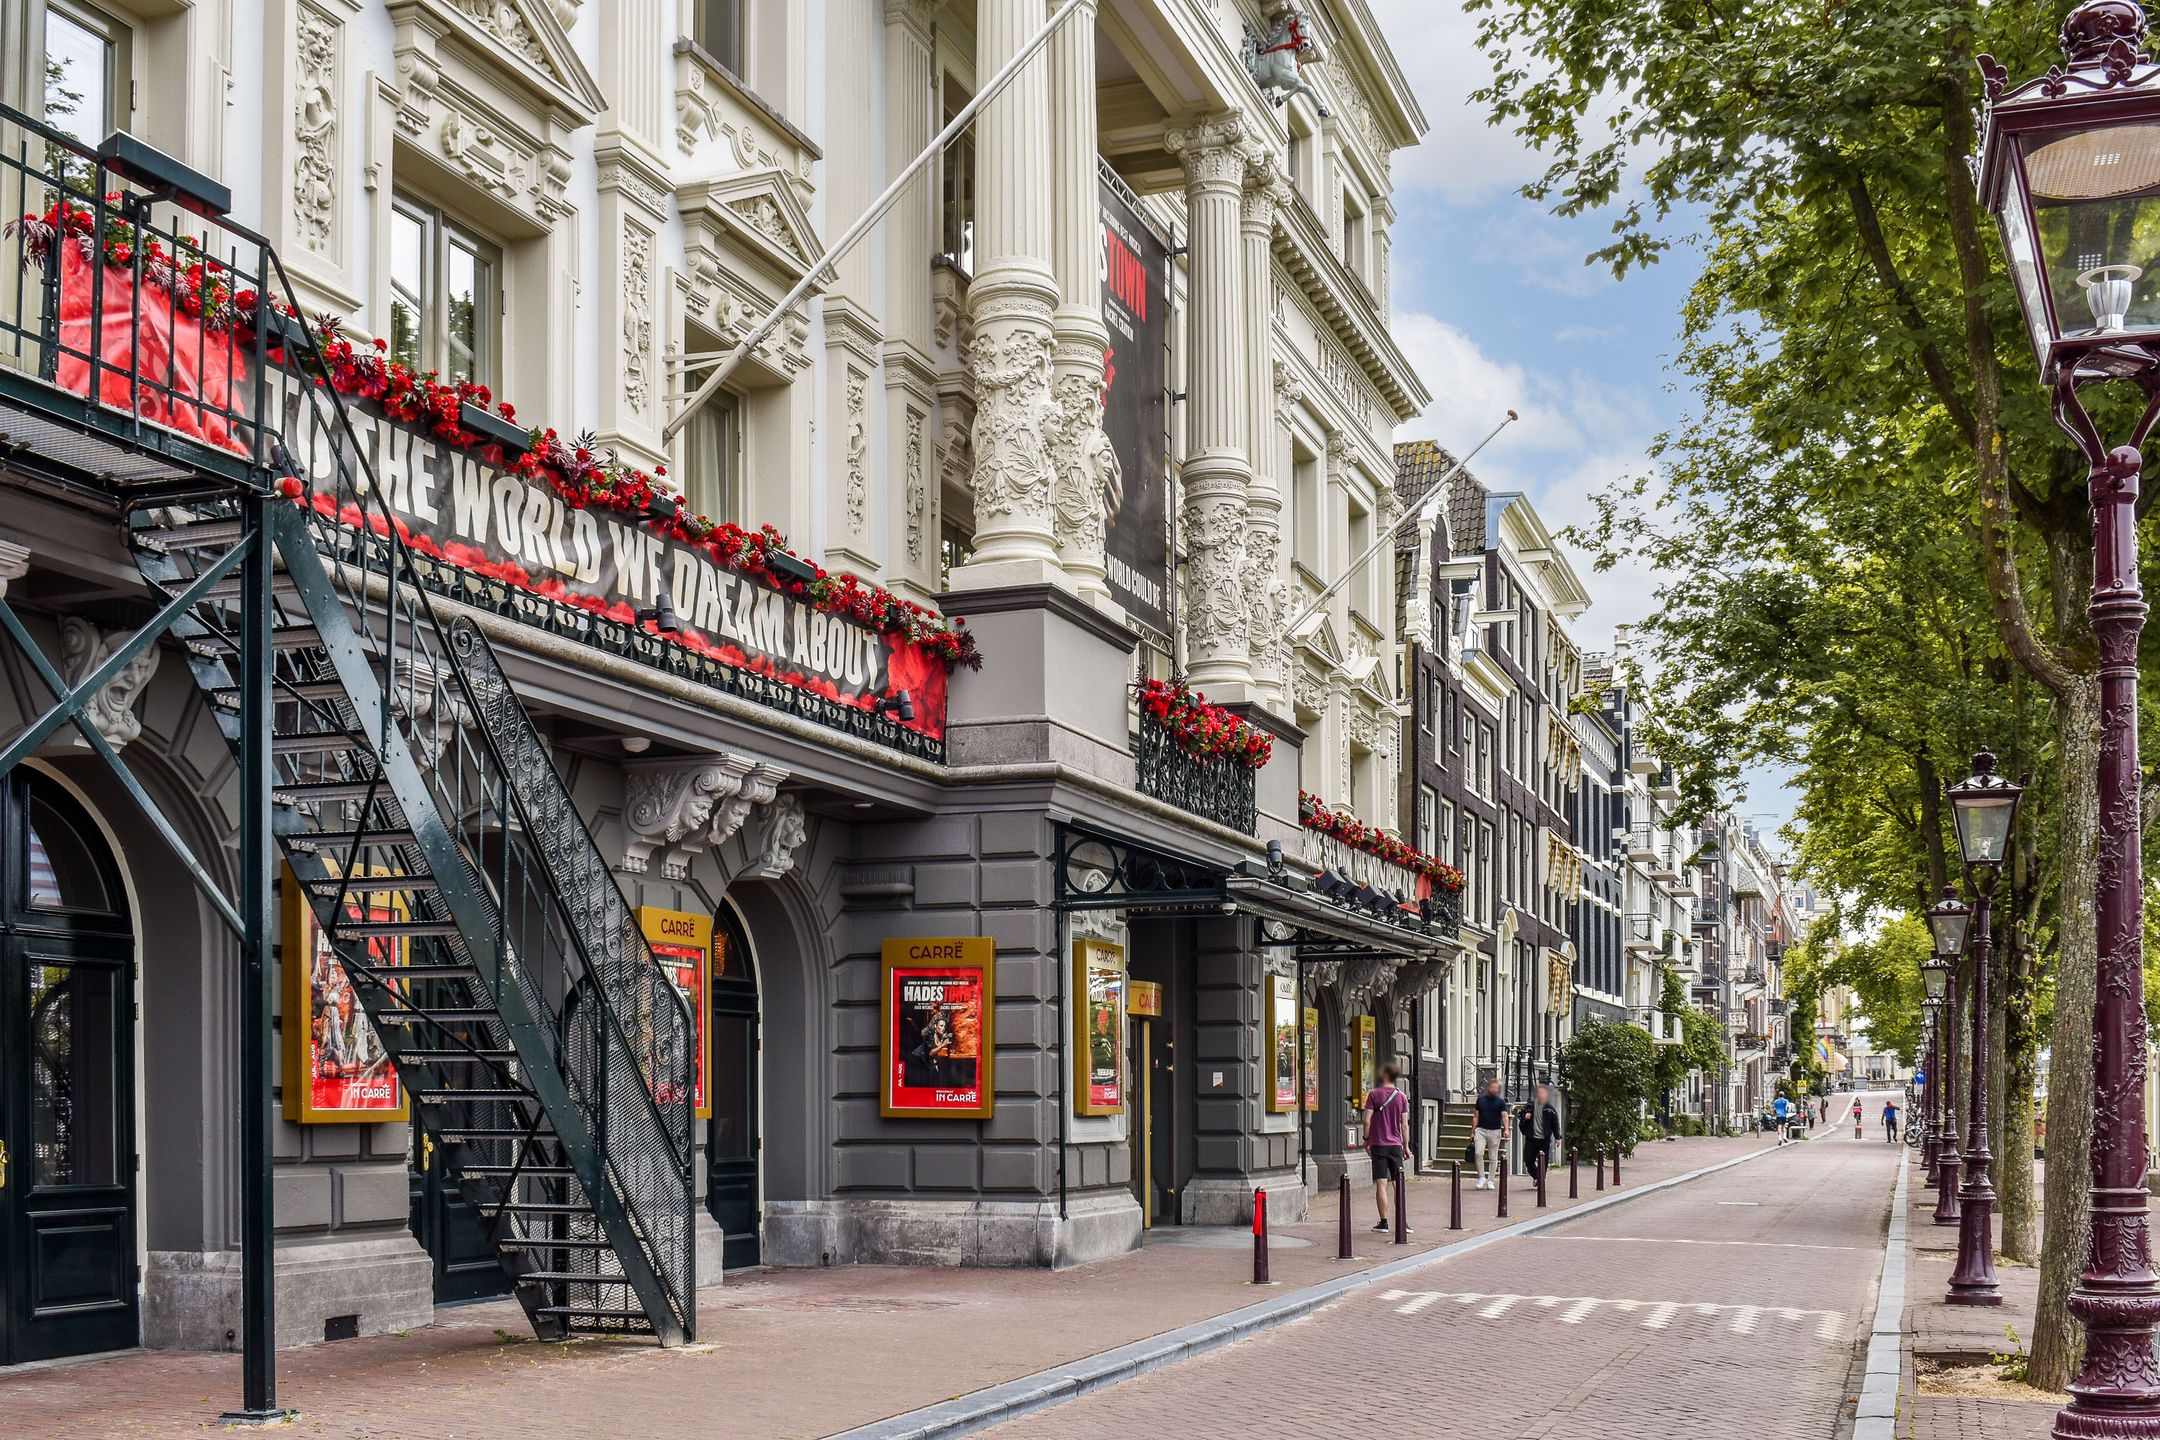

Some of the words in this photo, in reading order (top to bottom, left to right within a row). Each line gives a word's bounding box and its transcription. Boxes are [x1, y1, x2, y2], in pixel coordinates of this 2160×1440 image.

[349, 404, 440, 526] THE
[450, 451, 602, 584] WORLD
[607, 520, 664, 608] WE
[671, 548, 787, 658] DREAM
[792, 603, 879, 690] ABOUT
[1106, 552, 1131, 591] WORLD
[1131, 569, 1153, 605] COULD
[1152, 582, 1161, 611] BE
[350, 1088, 360, 1098] IN
[936, 1093, 946, 1102] IN
